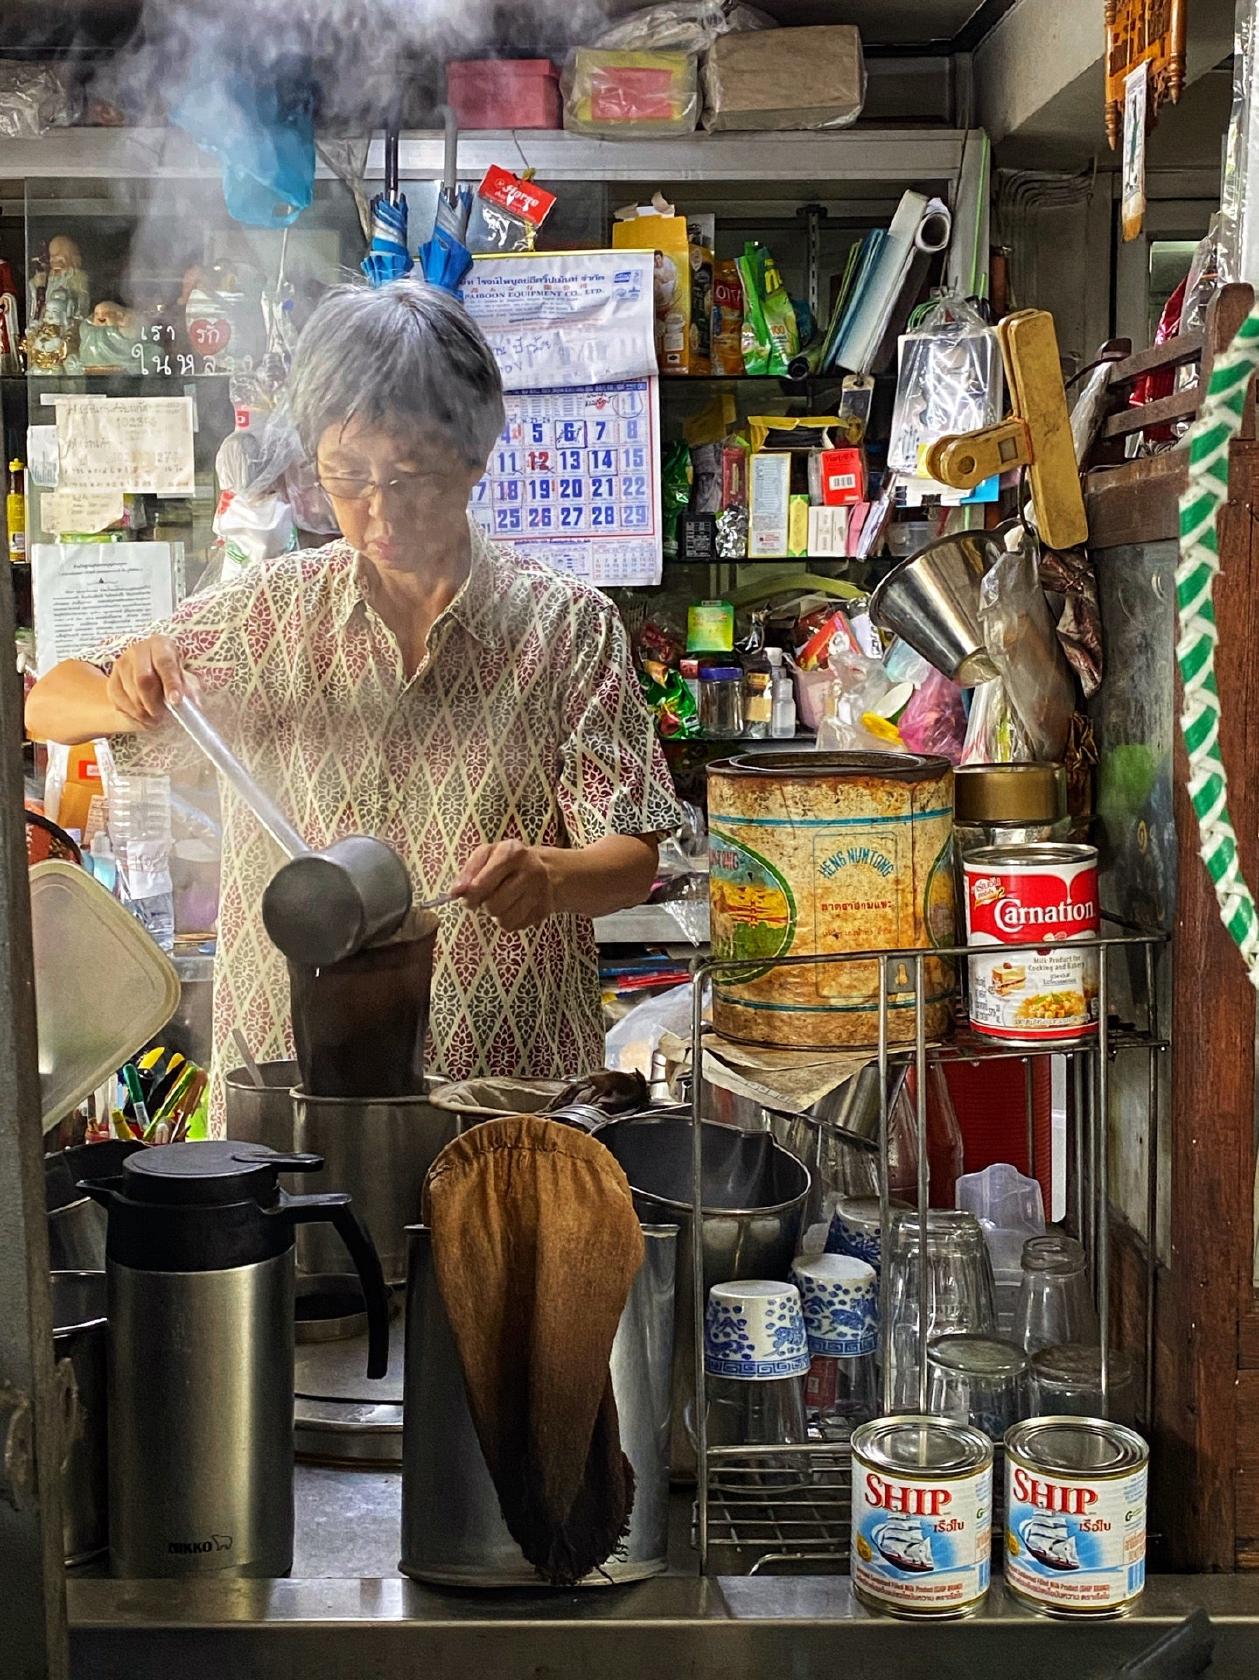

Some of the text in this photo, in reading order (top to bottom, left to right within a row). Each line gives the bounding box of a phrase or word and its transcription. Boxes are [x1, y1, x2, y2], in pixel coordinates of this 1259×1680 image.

[508, 289, 562, 298] EQUIPMENT
[141, 324, 220, 344] เรา รัก
[501, 420, 638, 444] 4 5 6 7 8
[498, 447, 644, 472] 11 12 13 14 15
[498, 480, 518, 501] 18
[529, 479, 550, 499] 19
[560, 478, 582, 498] 20
[591, 477, 613, 497] 21
[623, 476, 645, 496] 22
[497, 505, 646, 529] 25 26 27 28 29
[994, 898, 1094, 933] Carnation
[864, 1472, 953, 1516] SHIP
[1013, 1468, 1099, 1516] SHIP
[933, 1518, 965, 1534] เรือใบ
[1079, 1518, 1112, 1533] เรือใบ
[168, 1541, 212, 1553] NIKKO
